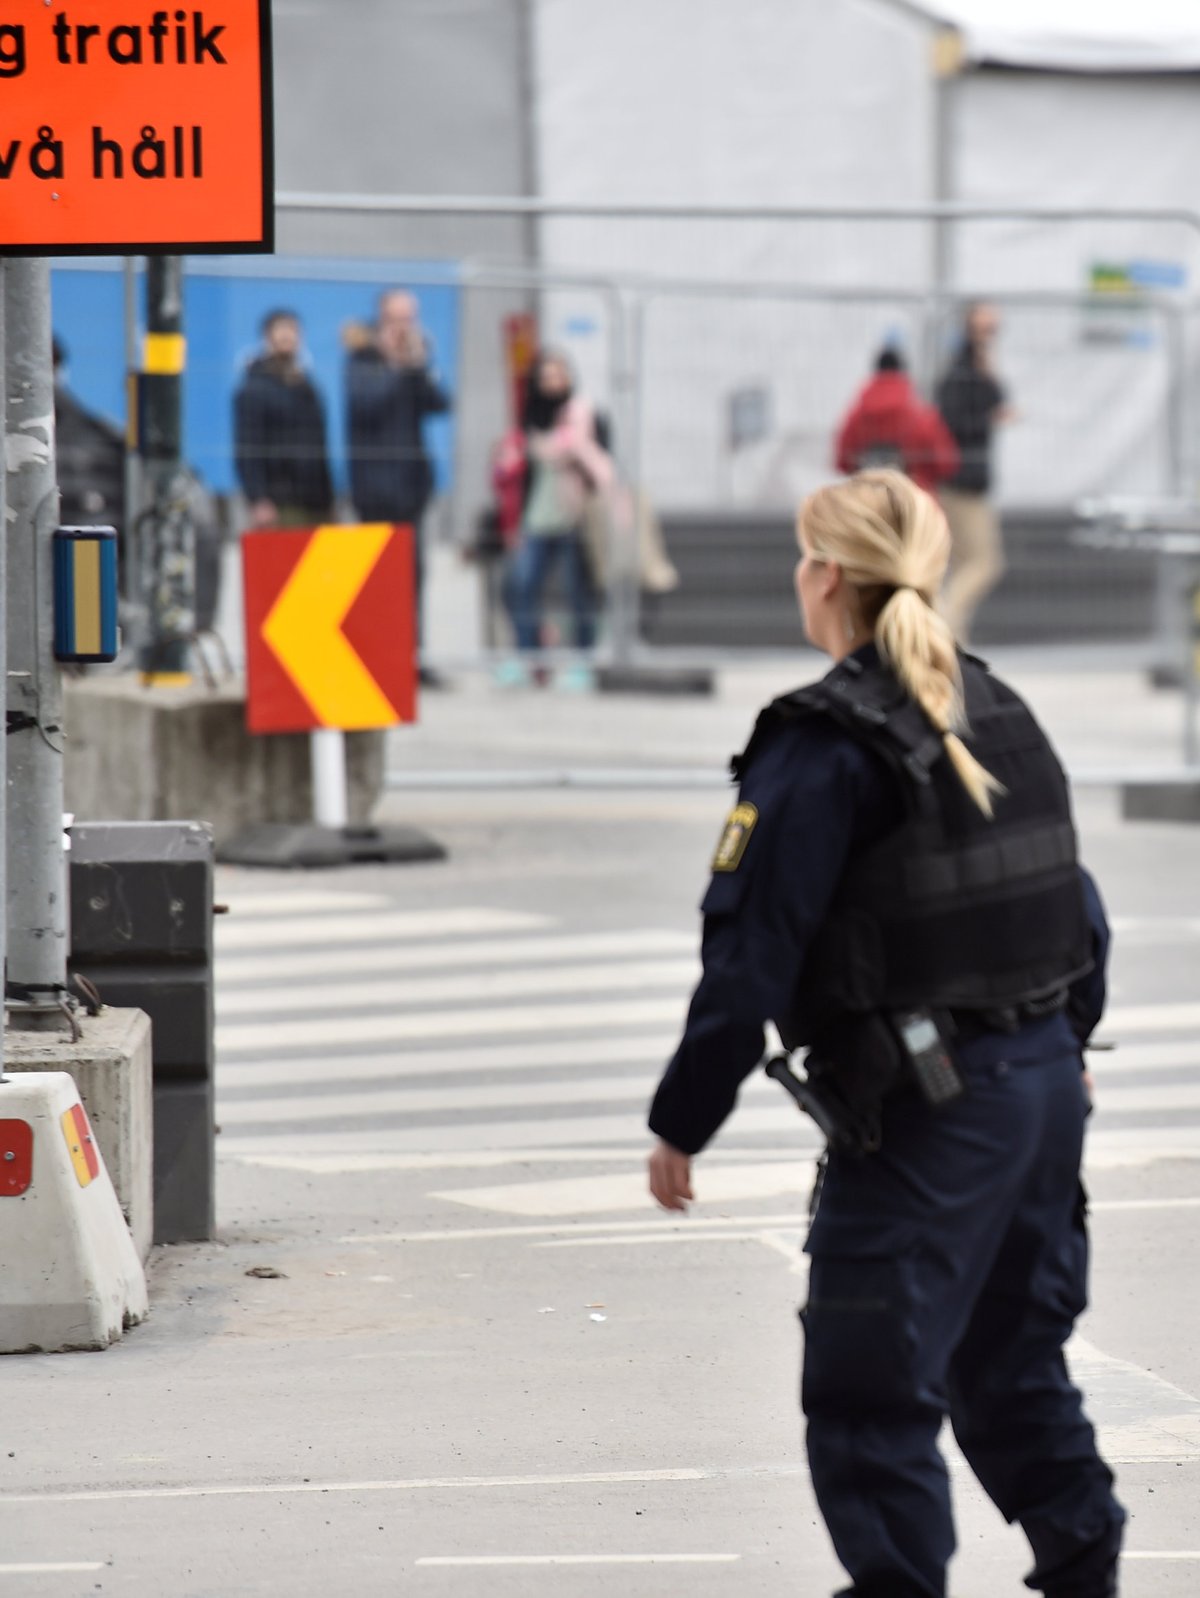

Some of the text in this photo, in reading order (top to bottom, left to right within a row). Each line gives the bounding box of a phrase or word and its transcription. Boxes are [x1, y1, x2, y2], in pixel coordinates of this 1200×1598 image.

[0, 10, 228, 78] g trafik
[0, 125, 202, 179] vå håll
